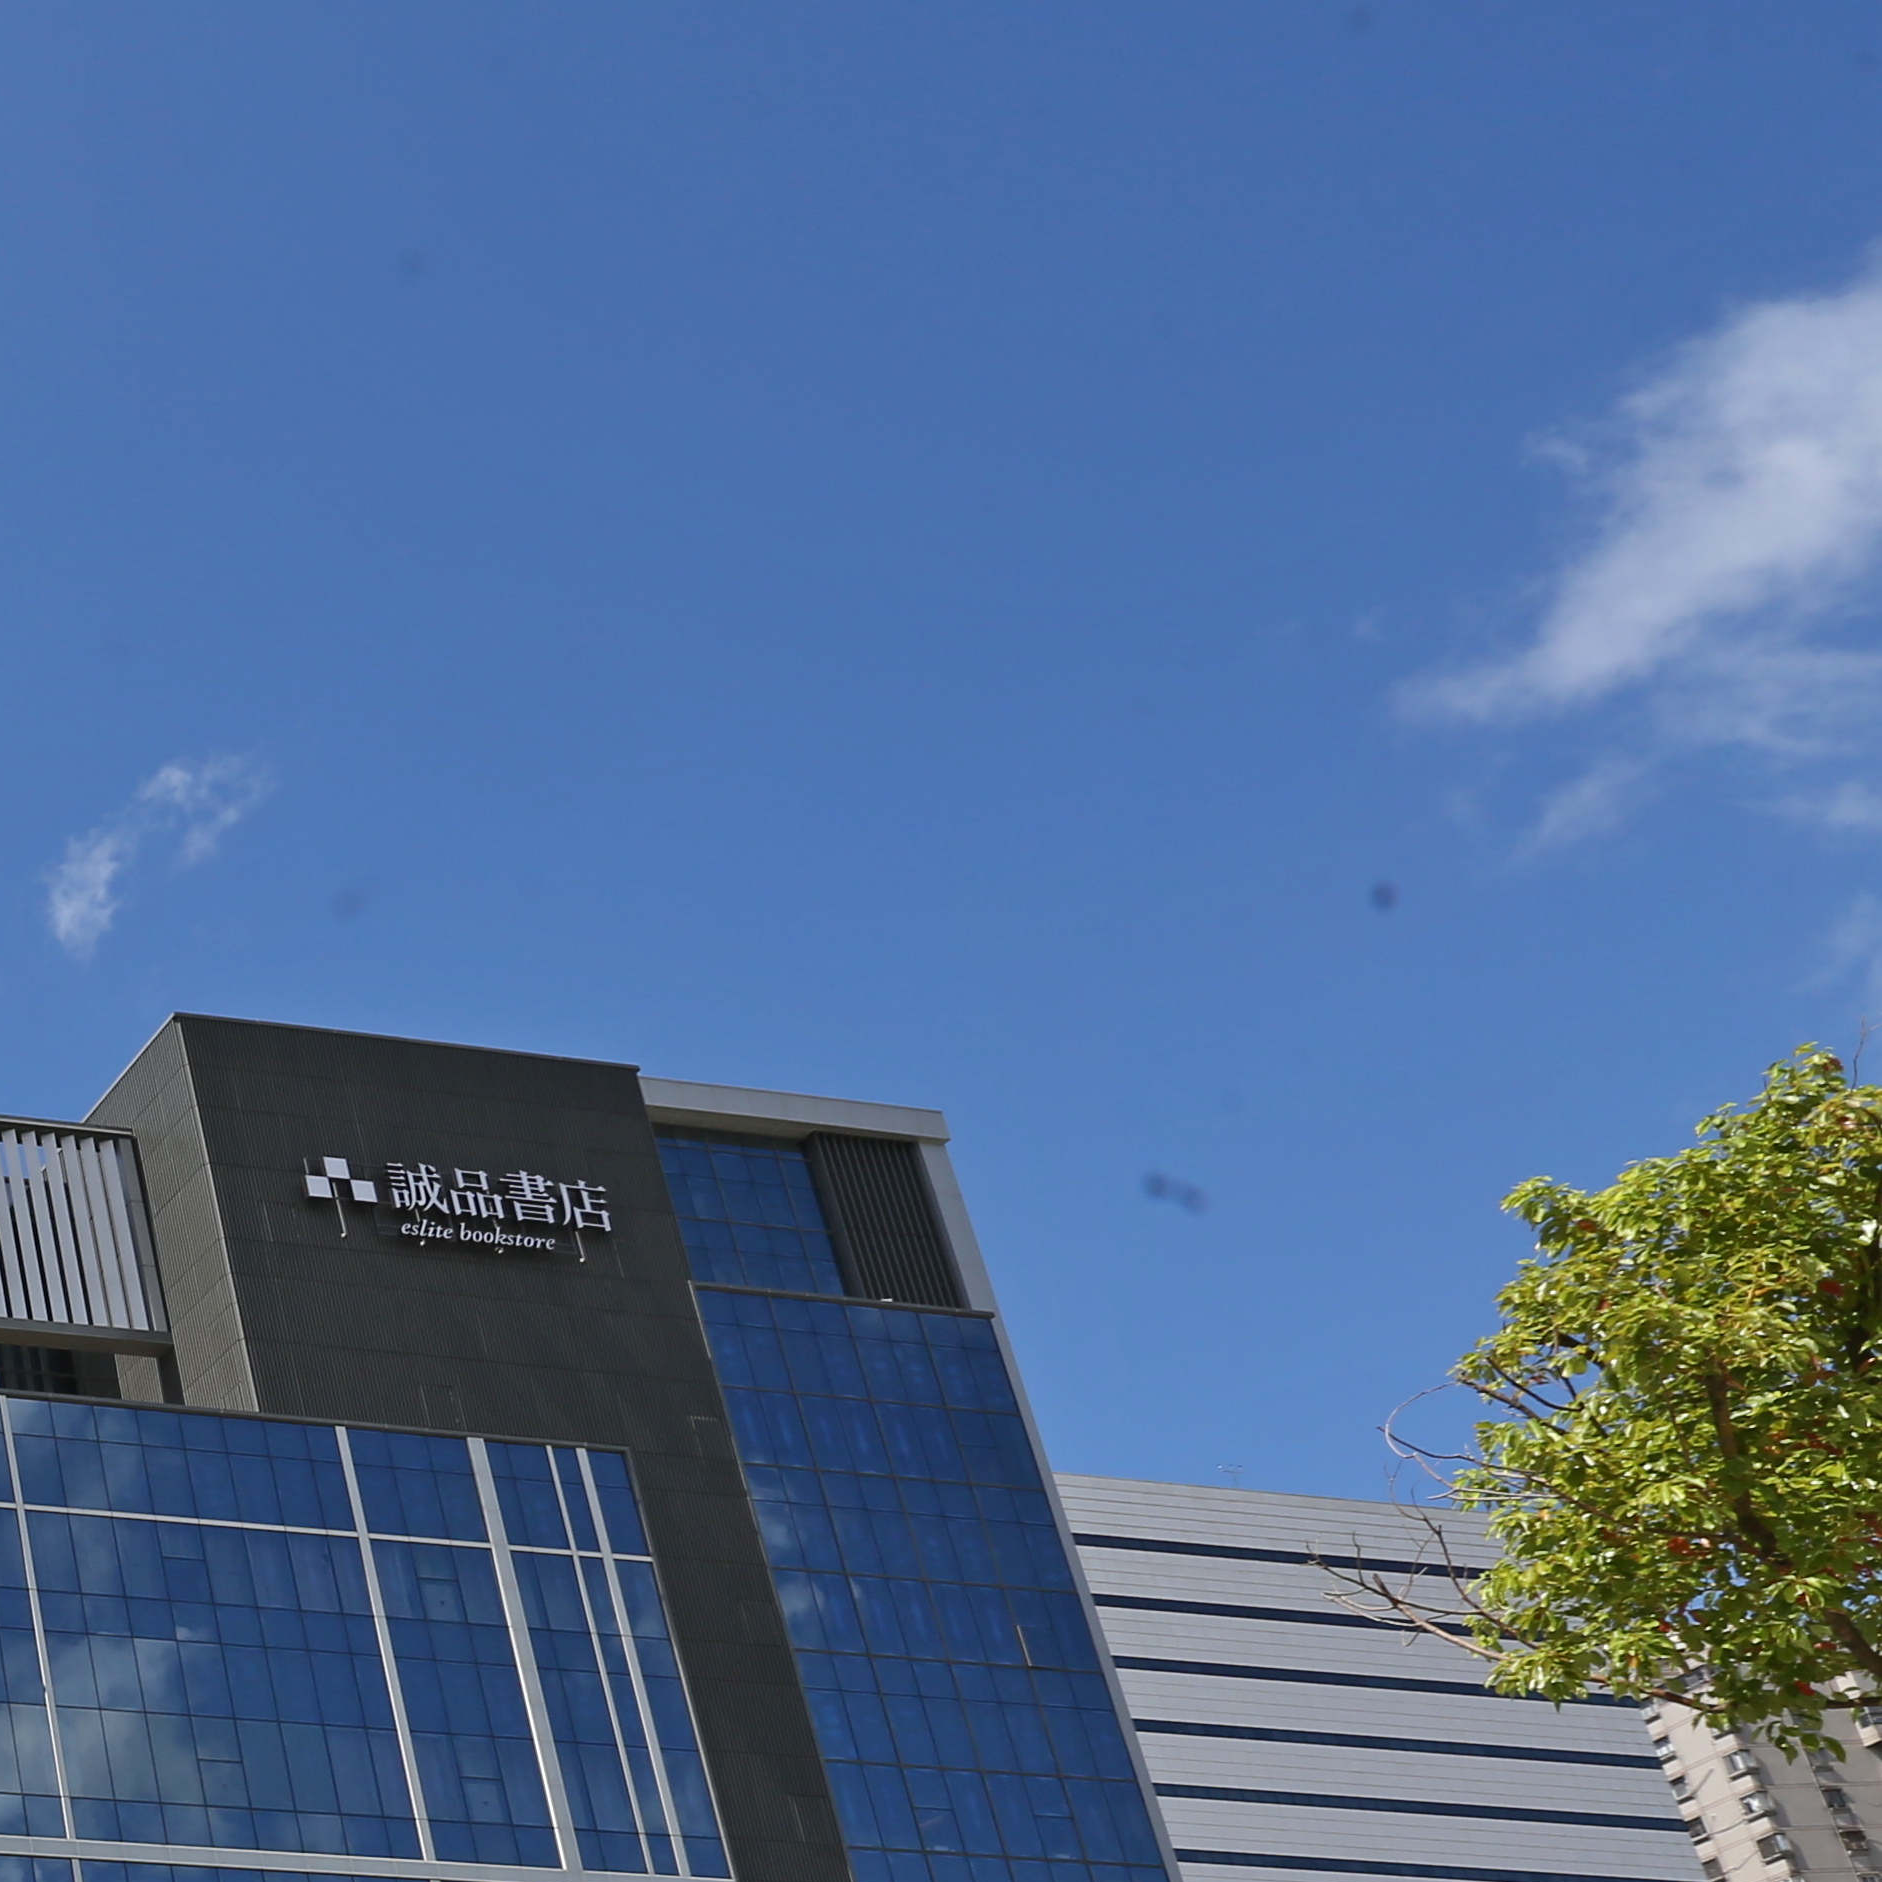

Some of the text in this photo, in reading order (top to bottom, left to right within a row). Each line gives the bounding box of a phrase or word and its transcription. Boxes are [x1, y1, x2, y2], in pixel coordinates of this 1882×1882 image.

[385, 1162, 613, 1233] 誠品書店
[400, 1219, 557, 1251] eslite bookstore
